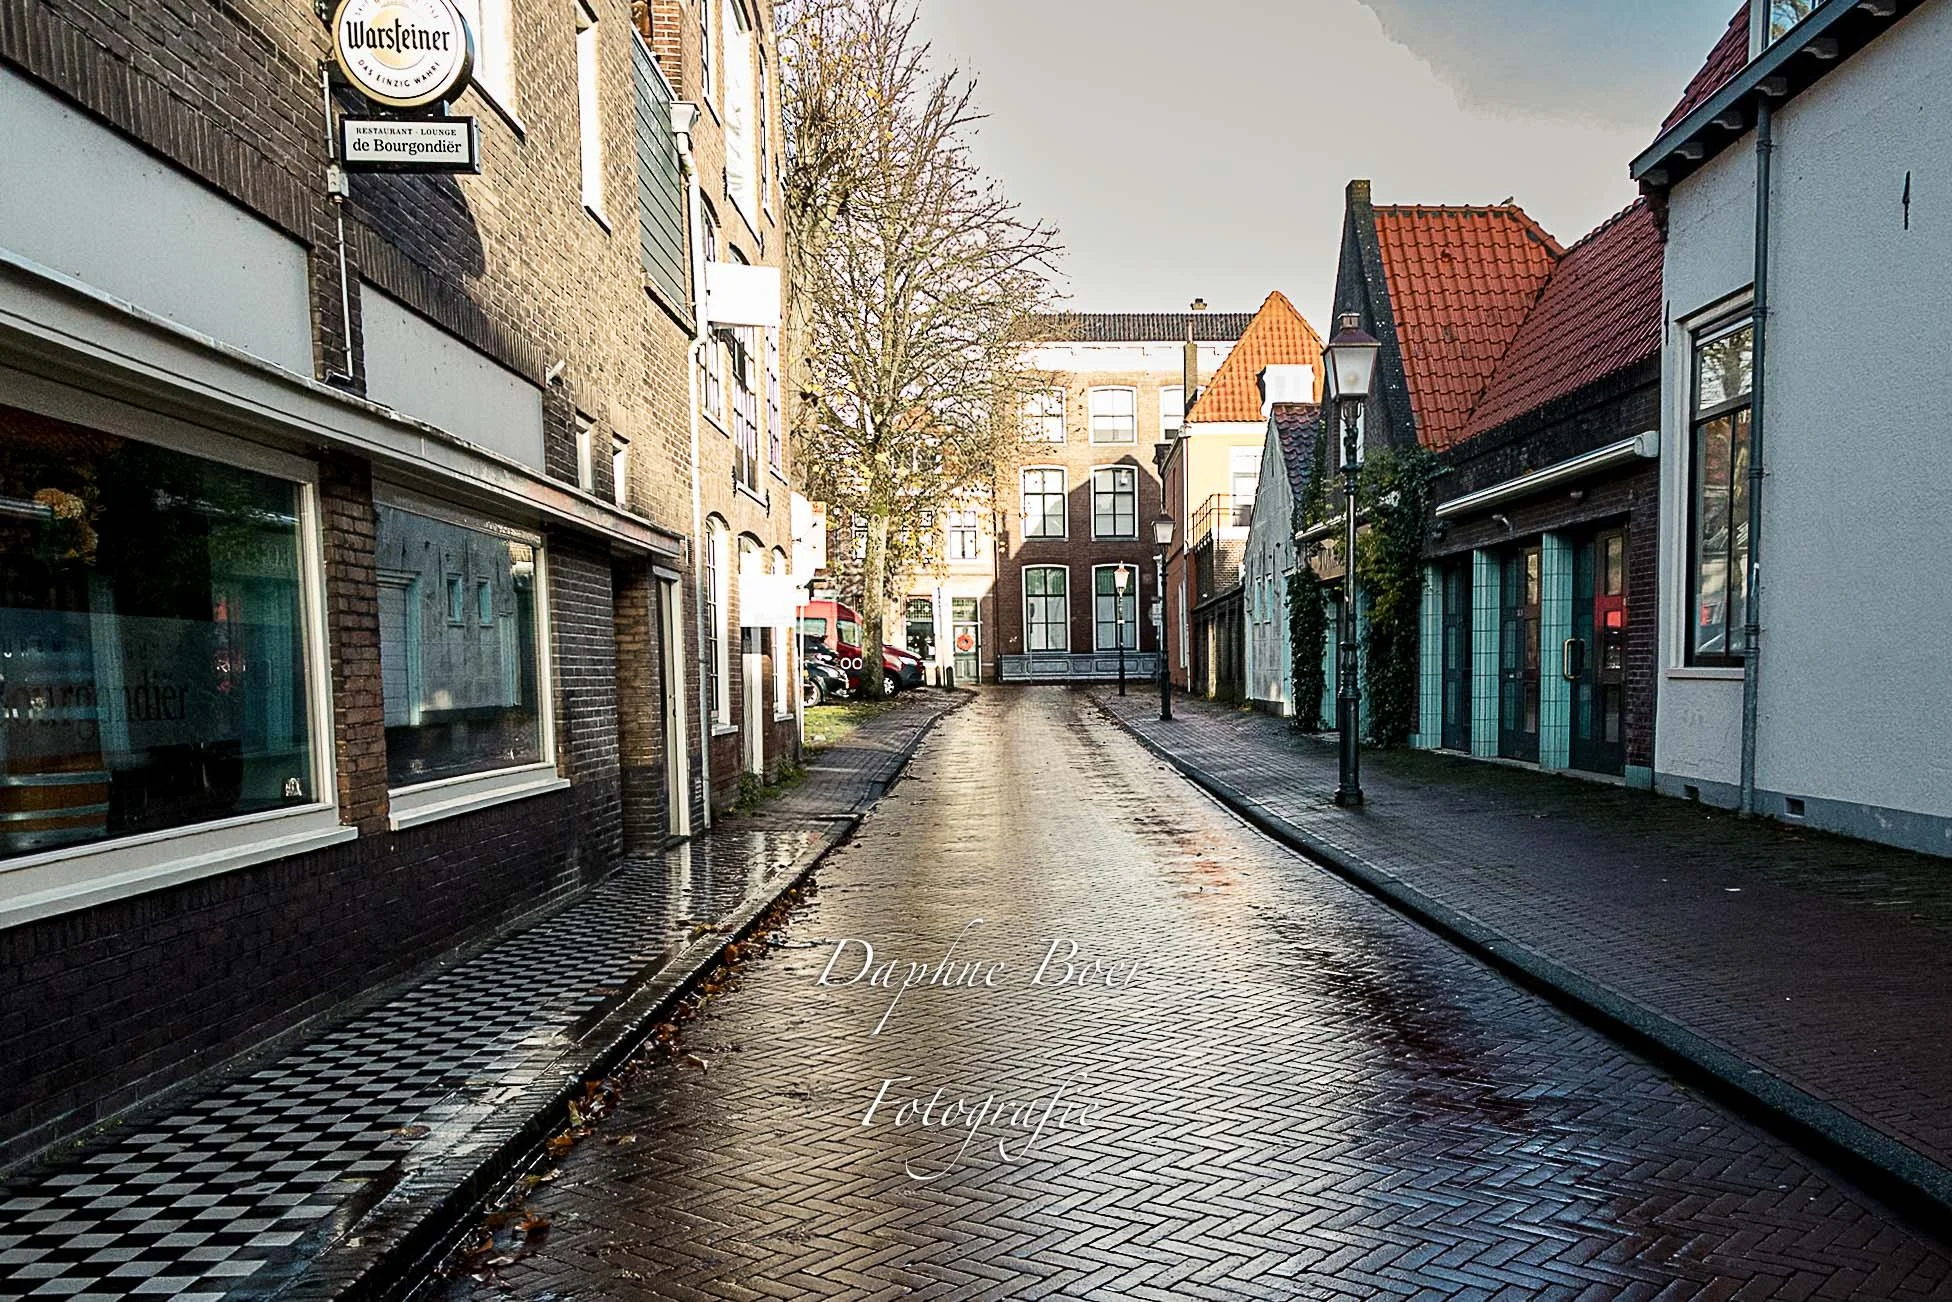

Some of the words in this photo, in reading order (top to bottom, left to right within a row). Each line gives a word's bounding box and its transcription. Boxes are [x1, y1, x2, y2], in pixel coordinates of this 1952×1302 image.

[346, 18, 450, 53] Warsteiner
[356, 127, 413, 136] RESTAURANT
[420, 128, 457, 137] LOUNGE
[352, 137, 370, 152] de
[373, 138, 462, 156] Bourgondiër
